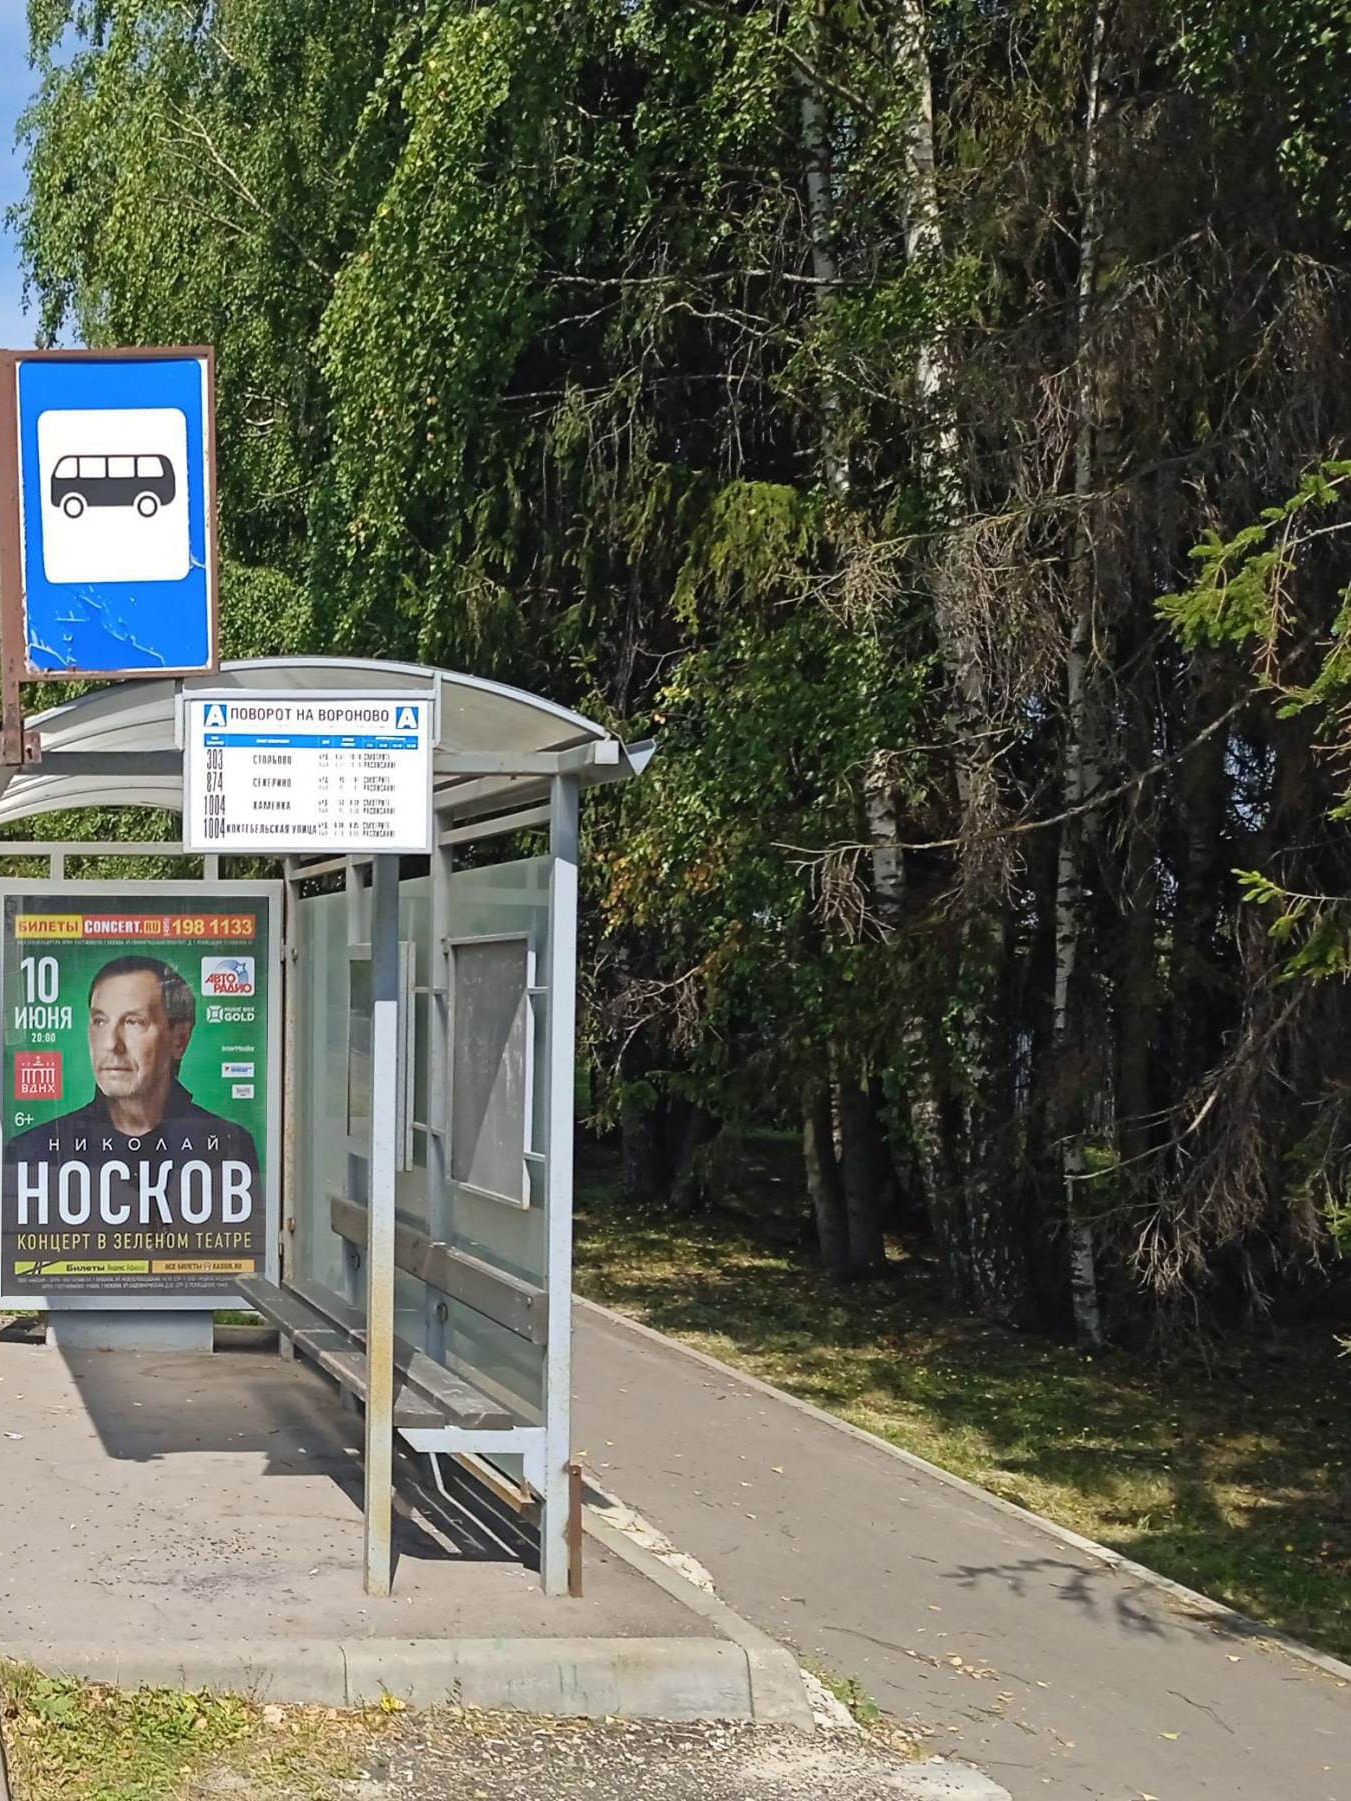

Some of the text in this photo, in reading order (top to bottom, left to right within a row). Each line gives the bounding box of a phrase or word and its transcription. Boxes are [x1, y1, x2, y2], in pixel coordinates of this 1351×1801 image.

[231, 707, 292, 721] ПОВОРОТ
[297, 708, 314, 721] НА
[318, 709, 389, 722] ВОРОНОВО
[206, 749, 223, 770] 303
[206, 771, 223, 792] 874
[204, 794, 225, 816] 1004
[204, 817, 225, 839] 1004
[226, 823, 290, 834] КОКТЕБЕЛЬСКАЯ
[292, 824, 317, 835] УЛИЦА
[18, 920, 78, 932] БИЛЕТЫ
[172, 919, 205, 935] 198
[209, 919, 252, 935] 1133
[20, 956, 59, 1004] 10
[205, 973, 236, 983] АВТО
[213, 983, 252, 993] РАДИО
[14, 1006, 72, 1029] ИЮНЯ
[224, 1012, 255, 1022] GOLD
[31, 1032, 56, 1043] 20:00
[21, 1083, 55, 1093] ВДНХ
[14, 1112, 34, 1126] 6+
[49, 1134, 219, 1151] НИКОЛАЙ
[17, 1159, 252, 1225] НОСКОВ
[17, 1232, 251, 1252] КОНЦЕРТ В ЗЕЛЕНОМ ТЕАТРЕ
[66, 1264, 105, 1272] Билеты
